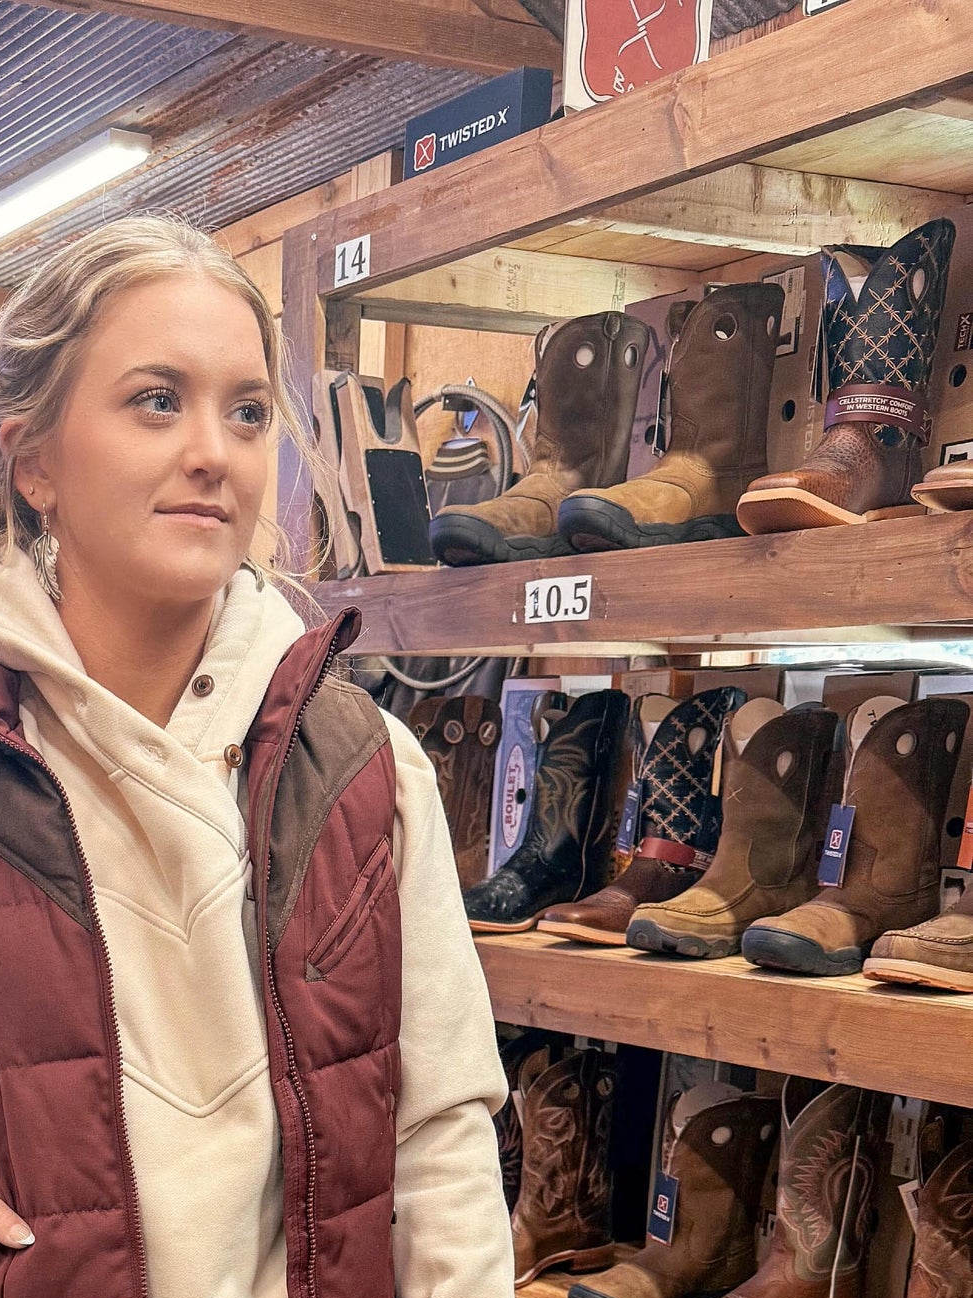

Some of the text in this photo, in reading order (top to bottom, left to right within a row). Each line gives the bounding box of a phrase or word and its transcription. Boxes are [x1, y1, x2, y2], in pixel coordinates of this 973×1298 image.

[439, 107, 509, 151] TWISTED X
[337, 241, 366, 282] 14
[839, 397, 914, 412] CELLSTRETCH COMFORT
[856, 403, 889, 412] WESTERN
[889, 407, 908, 417] BOOTS
[529, 580, 588, 619] 10.5
[505, 766, 517, 825] BOULET
